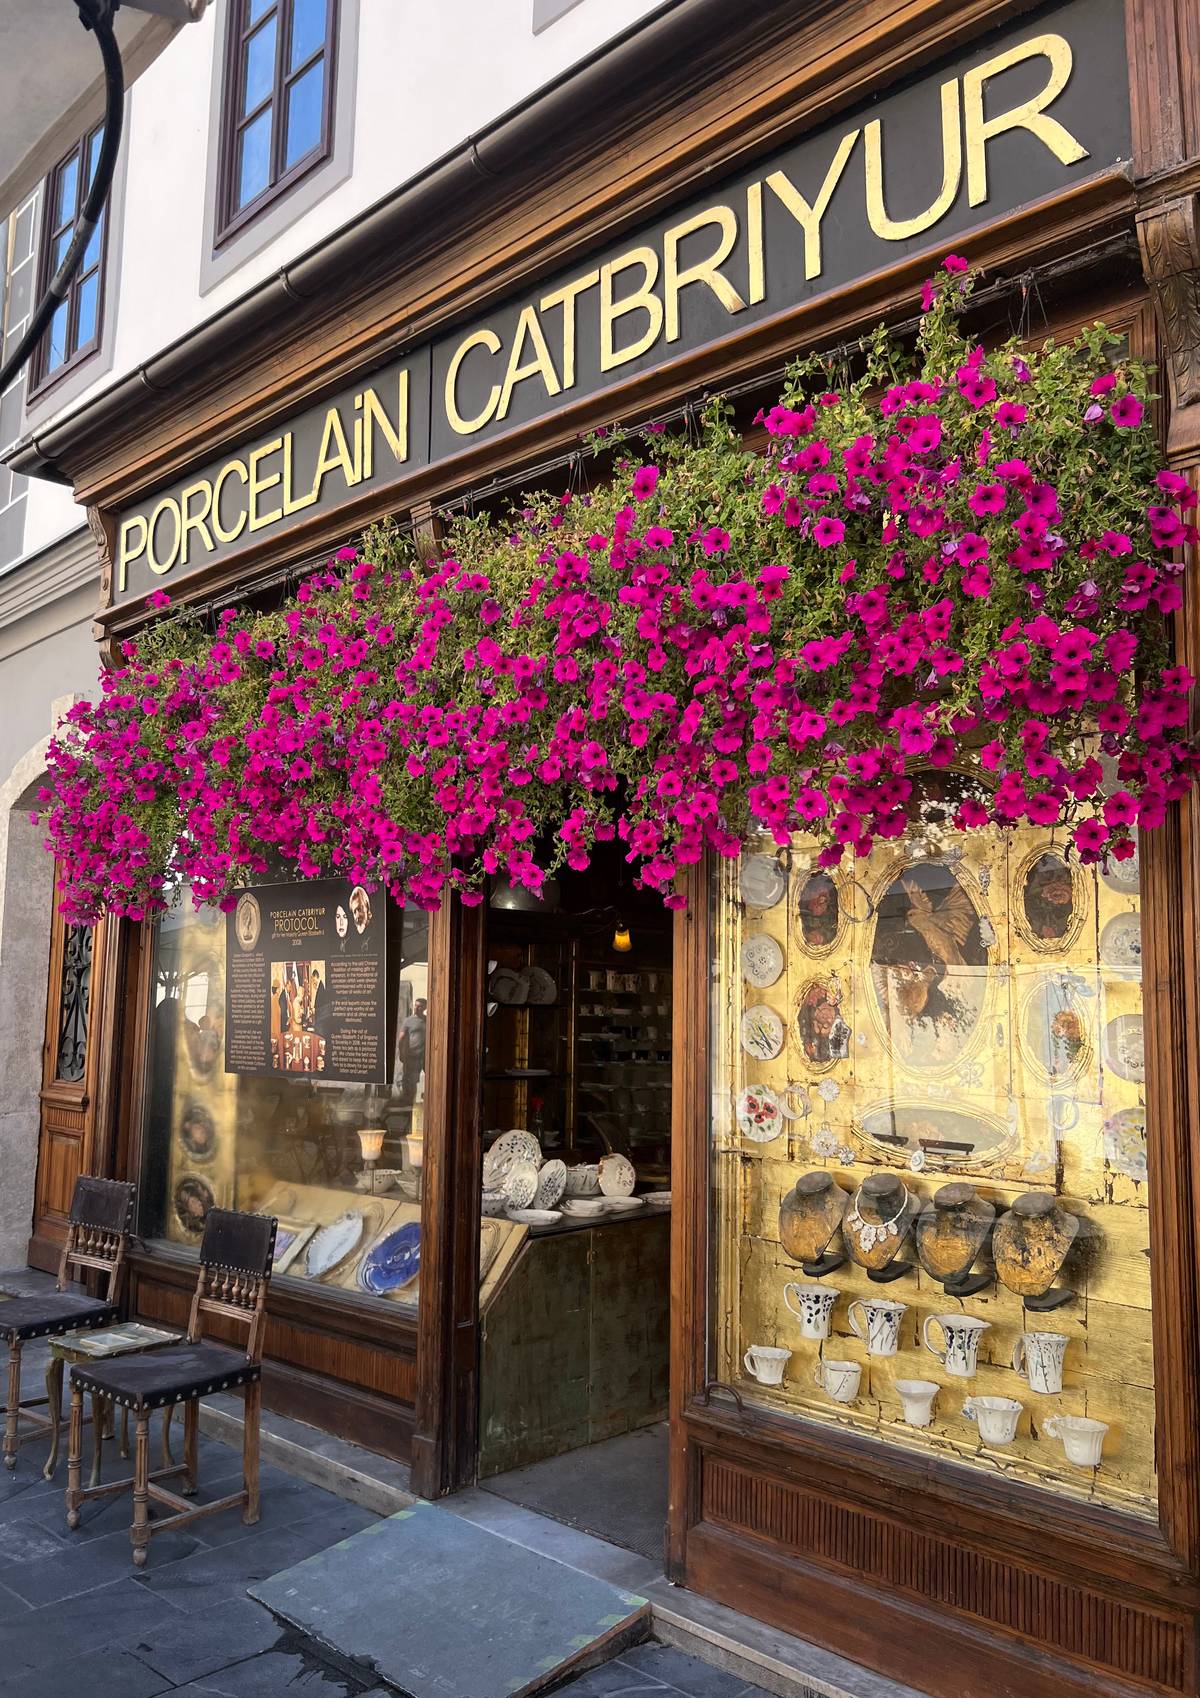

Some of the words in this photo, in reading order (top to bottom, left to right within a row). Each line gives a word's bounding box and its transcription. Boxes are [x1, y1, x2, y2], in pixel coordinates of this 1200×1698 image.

[444, 33, 1090, 435] CATBRIYUR
[298, 907, 326, 916] CATBRIYUR
[274, 917, 318, 932] PROTOCOL
